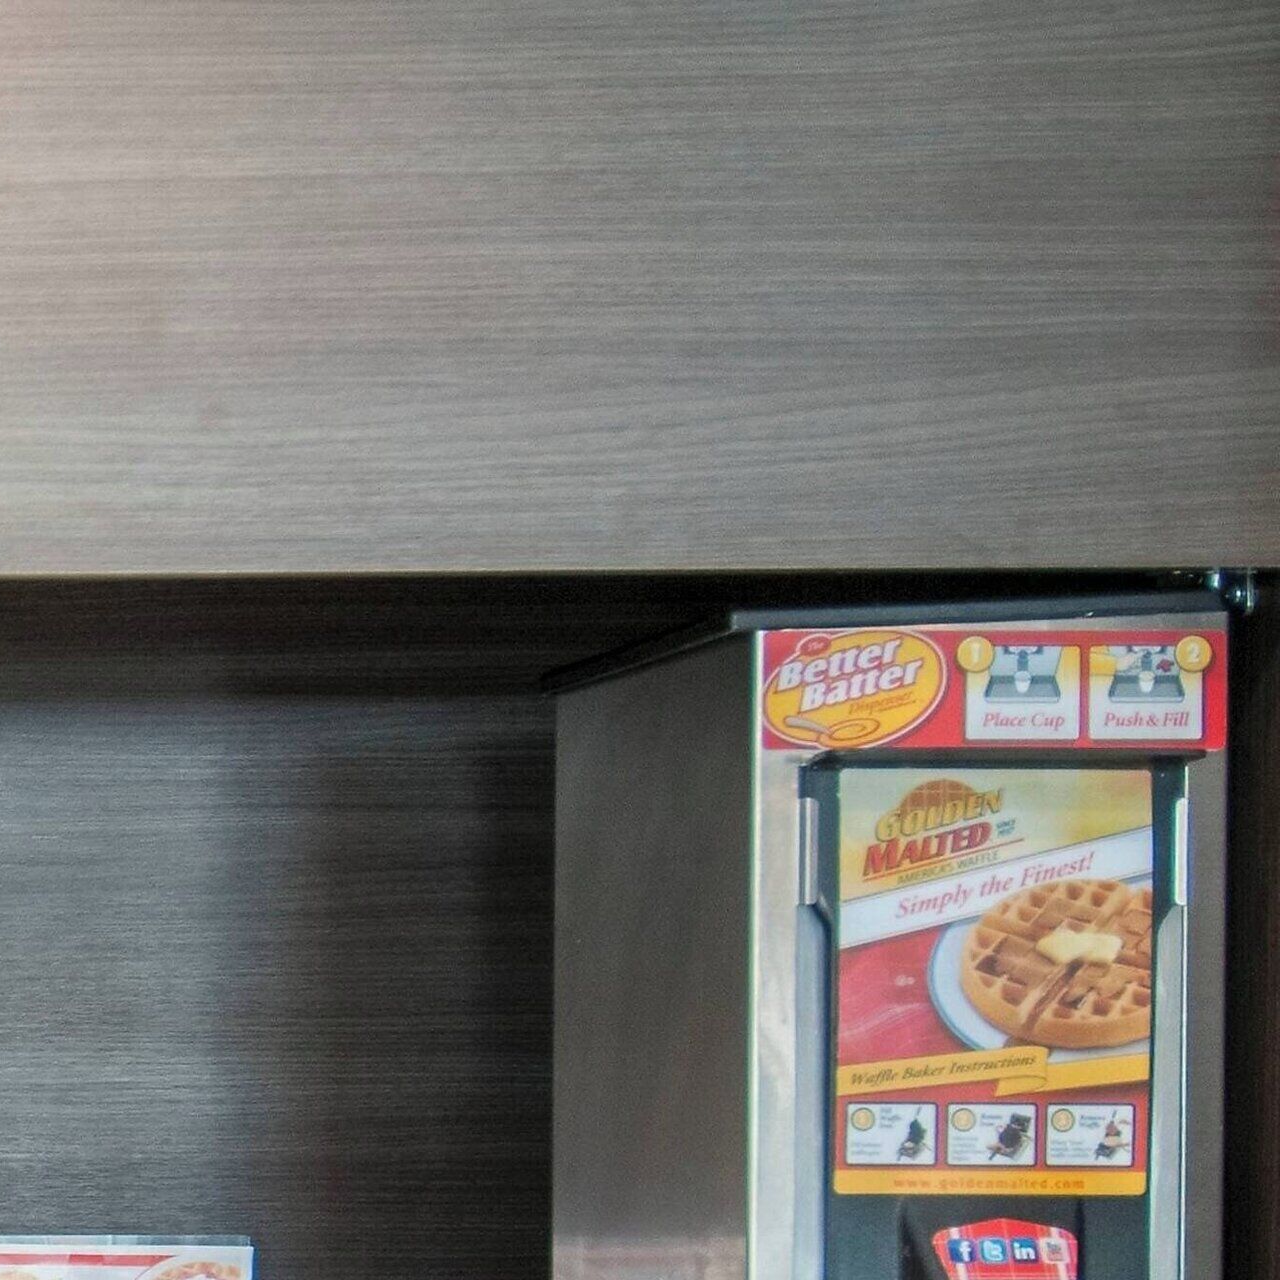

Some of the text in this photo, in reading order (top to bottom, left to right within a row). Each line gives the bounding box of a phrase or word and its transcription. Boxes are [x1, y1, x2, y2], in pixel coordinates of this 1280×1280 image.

[776, 638, 902, 693] Better
[969, 644, 982, 664] 1
[1186, 645, 1201, 664] 2
[799, 659, 923, 713] Batter
[982, 711, 1066, 732] Place Cup
[1103, 711, 1190, 728] Push & Fill
[875, 787, 1004, 842] GOLDEN
[862, 821, 992, 878] MALTED
[895, 850, 1096, 919] Simply the Finest!
[850, 1054, 1037, 1088] Waffle Baker Instructions
